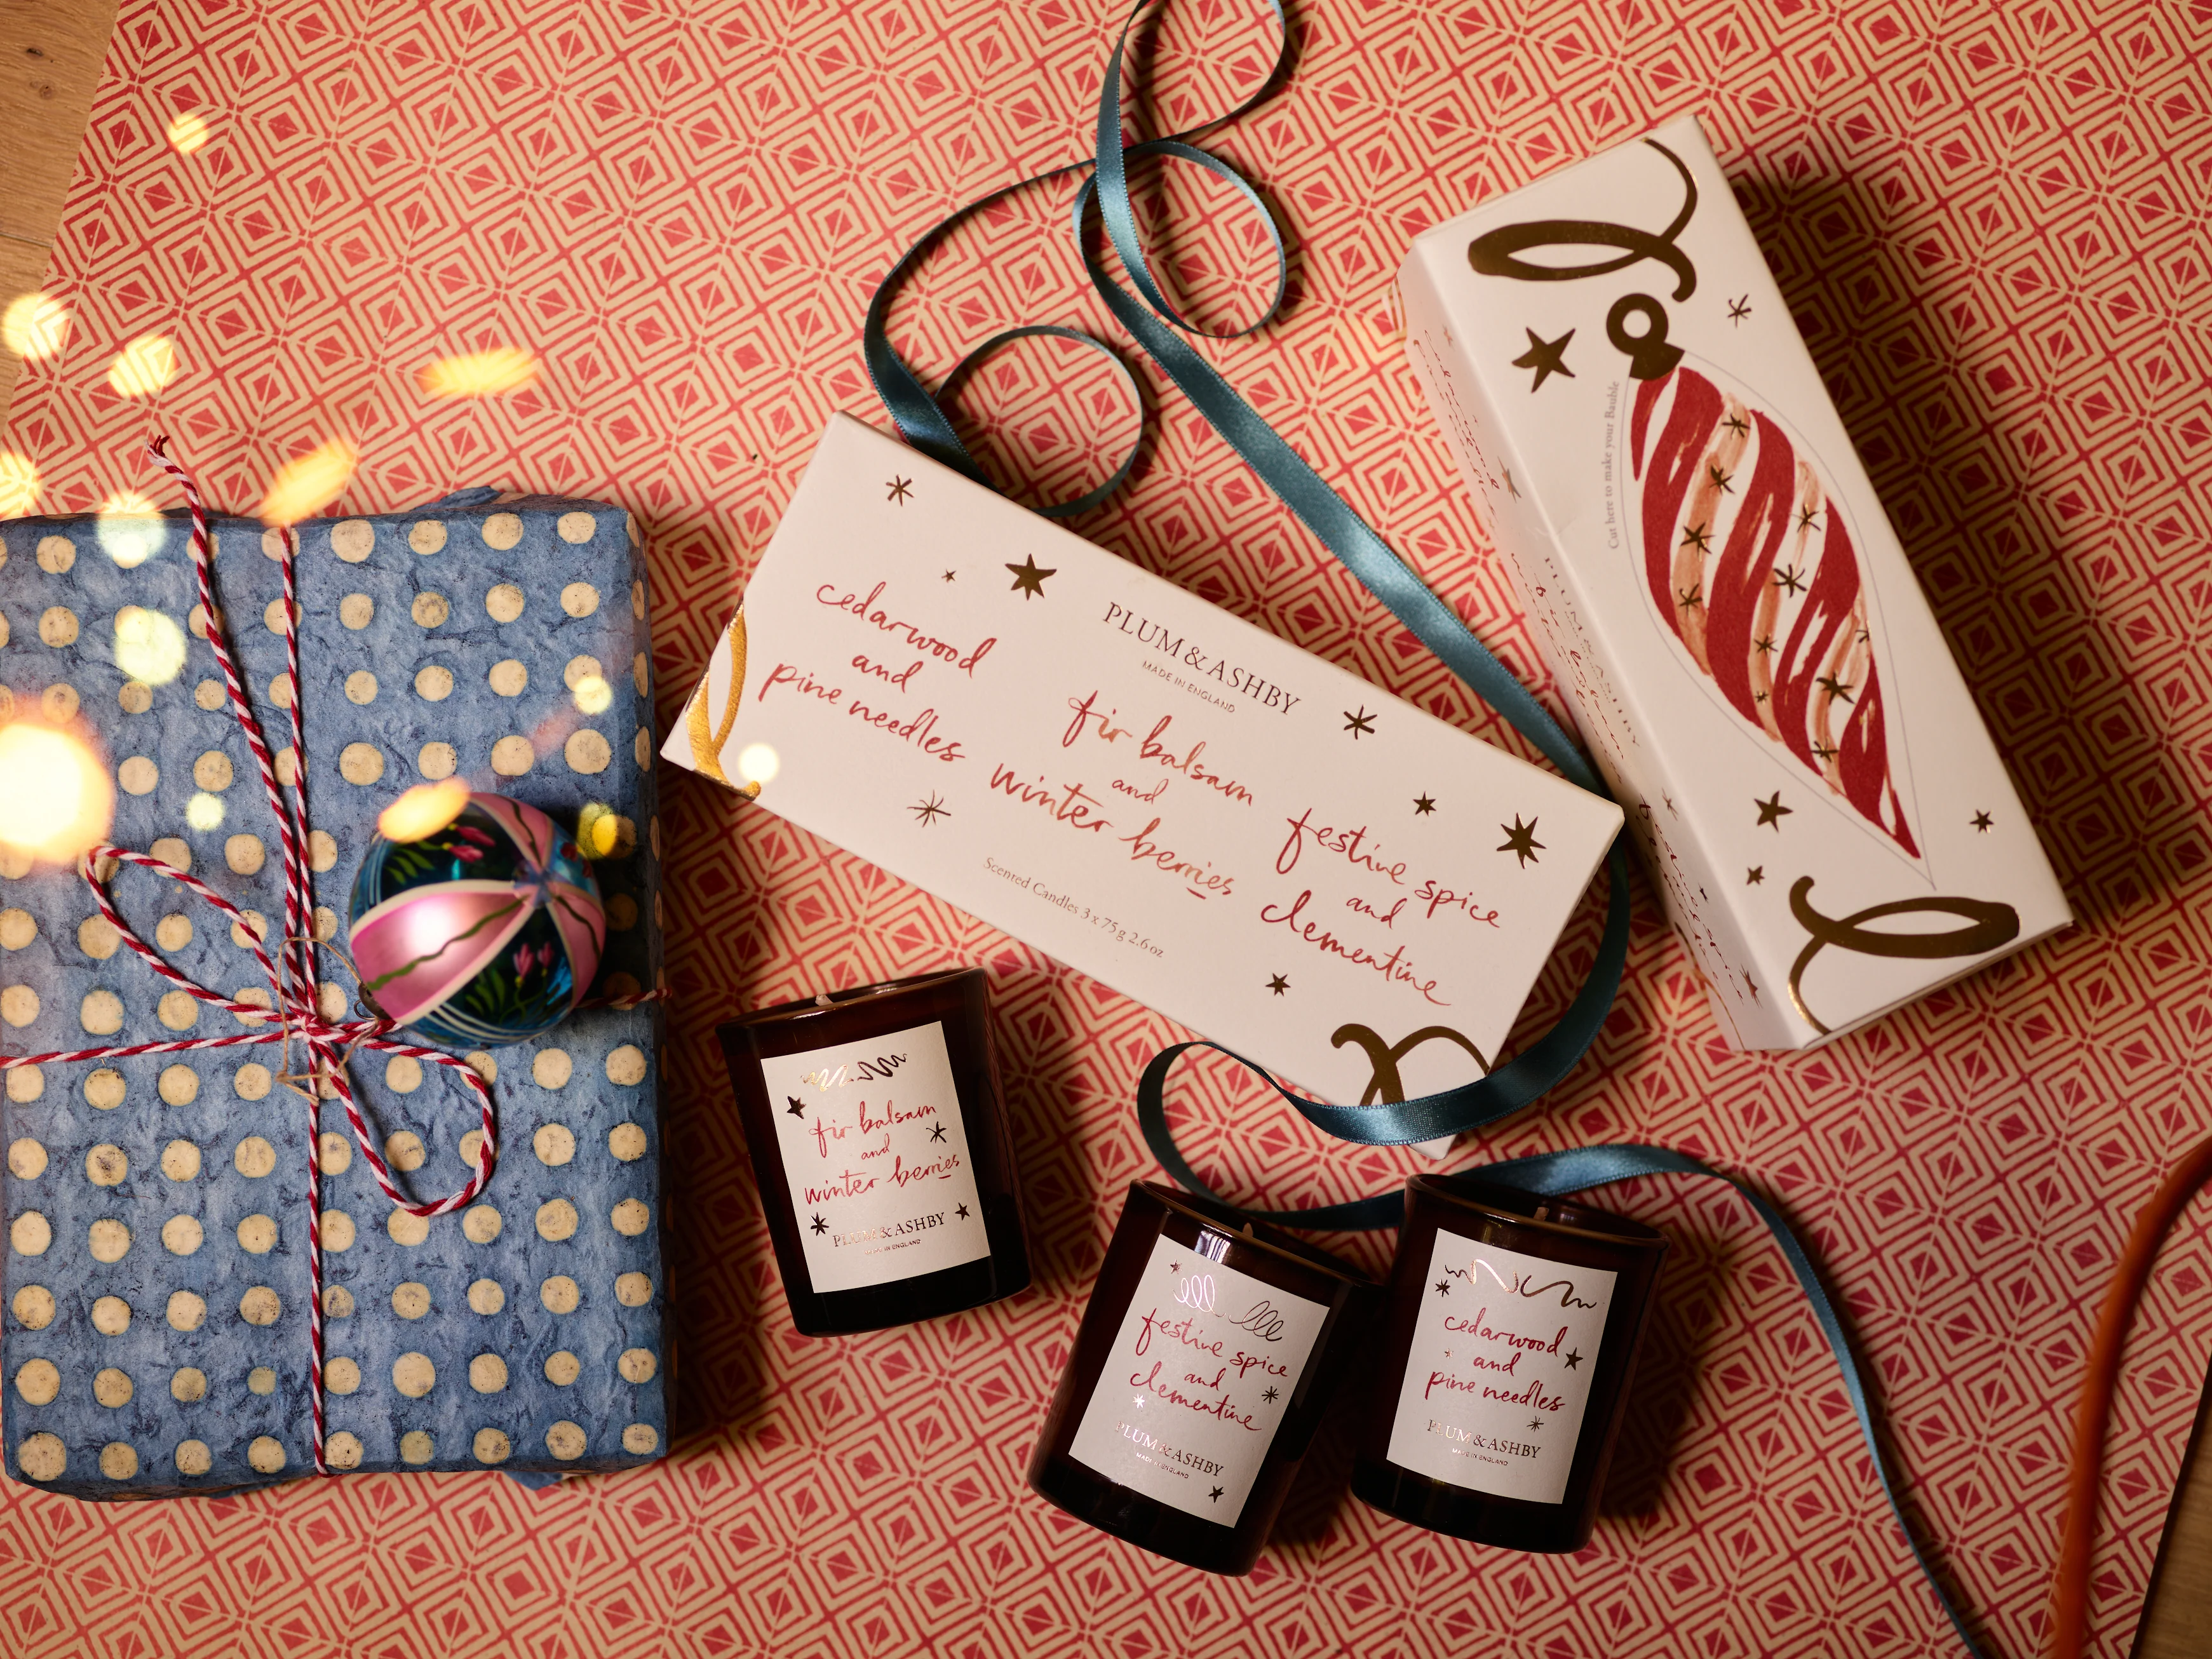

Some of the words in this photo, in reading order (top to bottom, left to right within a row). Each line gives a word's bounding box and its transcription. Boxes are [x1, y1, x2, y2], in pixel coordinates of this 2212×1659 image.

[1604, 381, 1620, 419] Bauble
[1605, 423, 1615, 449] your
[1601, 452, 1612, 481] make
[1605, 485, 1613, 497] to
[1605, 500, 1615, 525] here
[1608, 527, 1619, 549] Cut
[817, 581, 997, 678] cedarwood
[852, 655, 923, 693] and
[1102, 601, 1185, 659] PLUM
[1185, 647, 1206, 671] &
[1206, 660, 1302, 716] ASHBY
[1142, 661, 1173, 682] MADE
[1175, 677, 1186, 688] IN
[1187, 683, 1236, 713] ENGLAND
[758, 663, 842, 704] pine
[849, 701, 966, 762] needles
[1063, 690, 1133, 748] fir
[1140, 715, 1253, 807] balsam
[1112, 779, 1169, 805] and
[990, 763, 1114, 831] winter
[1118, 817, 1235, 897] berries
[1276, 808, 1406, 885] festive
[1415, 880, 1500, 928] spice
[983, 857, 1031, 889] Scented
[1033, 883, 1079, 914] Candles
[1081, 908, 1090, 919] 3
[1091, 916, 1100, 925] x
[1346, 897, 1408, 929] and
[1260, 890, 1452, 1005] clementine
[809, 1117, 853, 1158] fir
[860, 1100, 936, 1134] balsam
[861, 1133, 890, 1160] and
[804, 1169, 880, 1205] winter
[886, 1154, 960, 1188] berries
[832, 1226, 877, 1247] PLUM
[879, 1226, 893, 1239] &
[895, 1212, 945, 1236] ASHBY
[865, 1246, 883, 1255] MADE
[892, 1239, 921, 1250] ENGLAND
[1135, 1308, 1223, 1357] festive
[1229, 1351, 1288, 1379] spice
[1445, 1307, 1568, 1357] cedarwood
[1184, 1368, 1227, 1391] and
[1473, 1352, 1521, 1377] and
[1130, 1361, 1262, 1432] clementine
[1424, 1371, 1476, 1400] pine
[1483, 1380, 1566, 1411] needles
[1115, 1420, 1158, 1451] PLUM
[1159, 1443, 1172, 1456] &
[1172, 1449, 1224, 1477] ASHBY
[1427, 1419, 1472, 1444] PLUM
[1473, 1434, 1487, 1447] &
[1487, 1438, 1541, 1459] ASHBY
[1452, 1447, 1469, 1458] MADE
[1479, 1454, 1508, 1466] ENGLAND
[1161, 1463, 1189, 1479] ENGLAND
